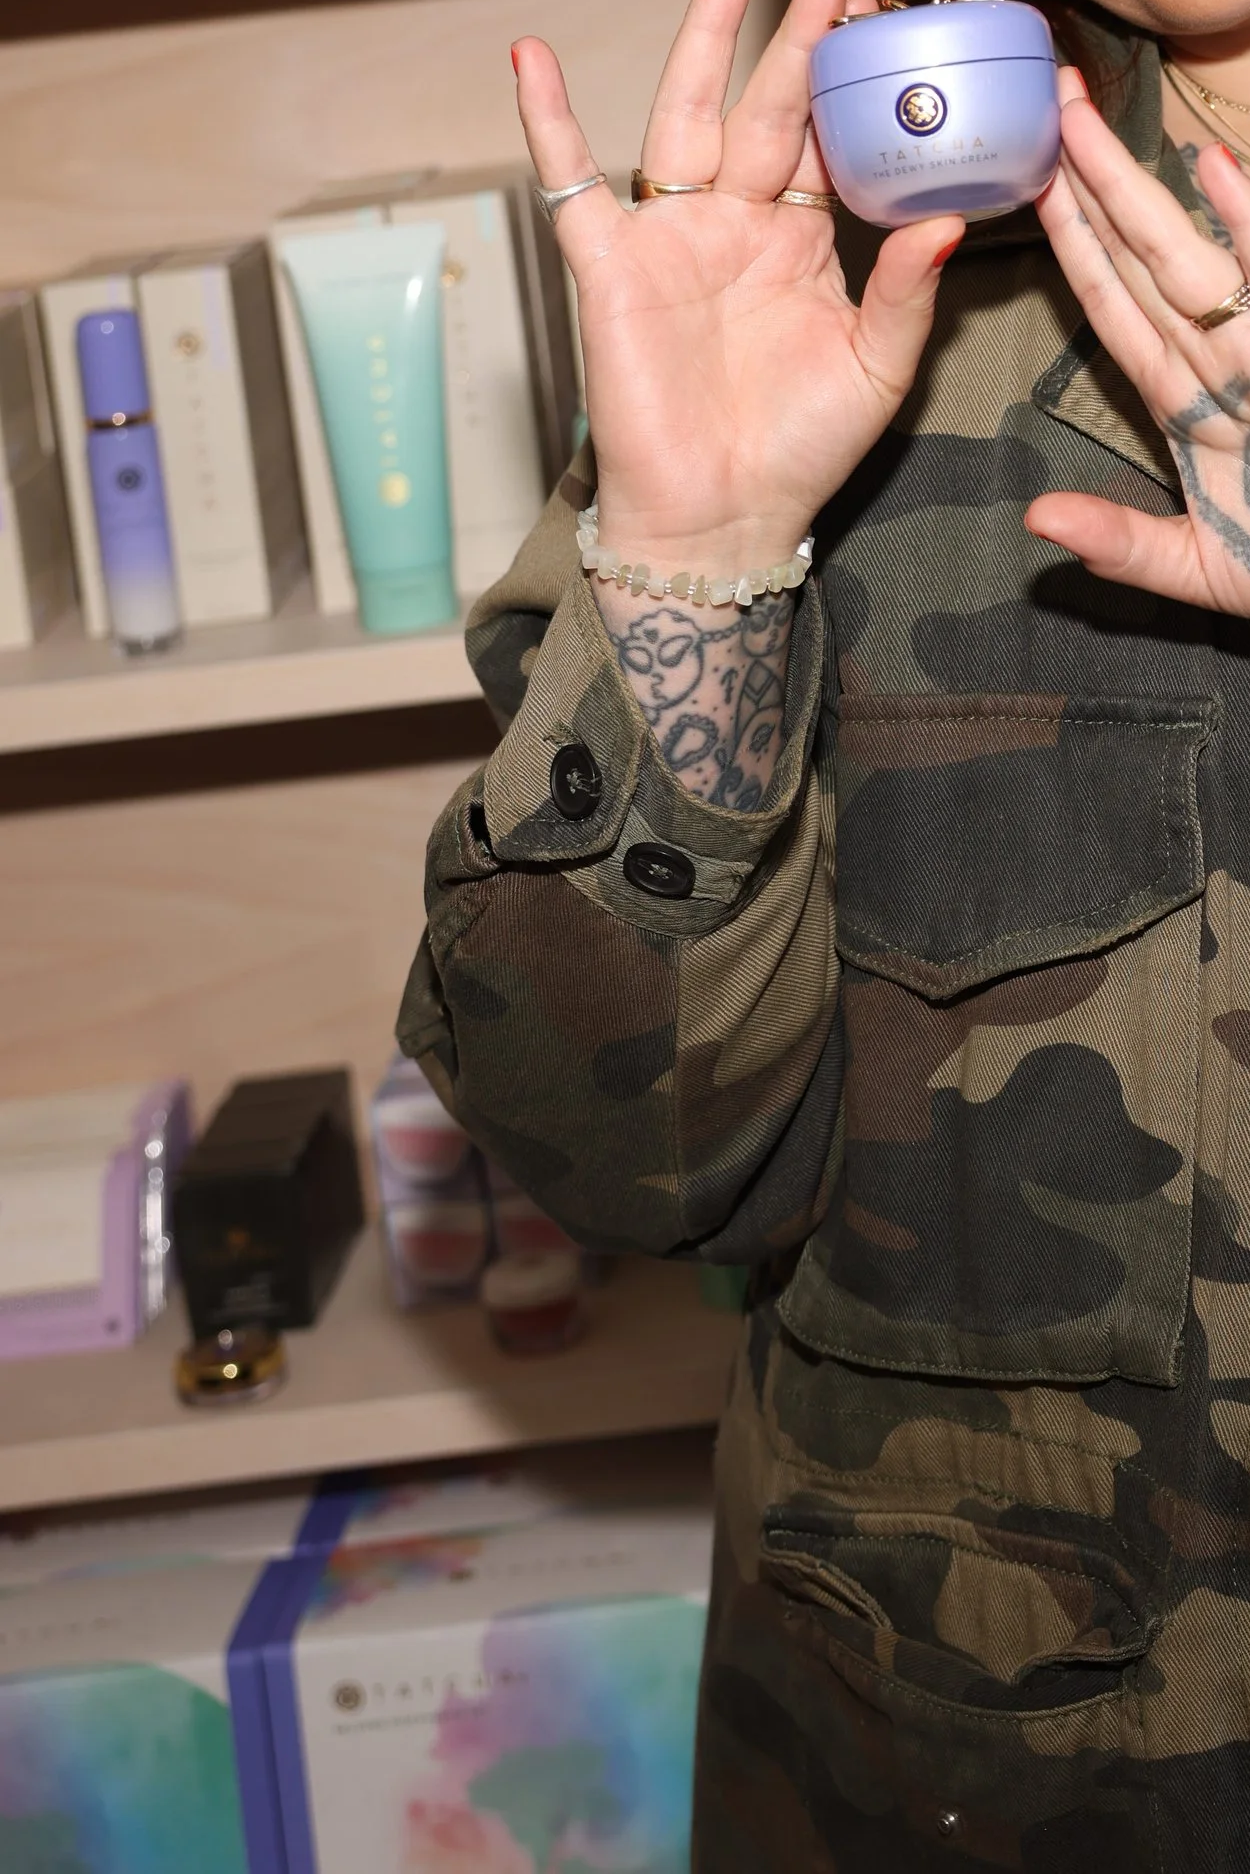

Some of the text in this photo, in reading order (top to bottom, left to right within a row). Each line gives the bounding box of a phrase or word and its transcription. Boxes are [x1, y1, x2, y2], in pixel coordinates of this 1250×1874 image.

[873, 153, 998, 181] THE DEWY SKIN CREAM
